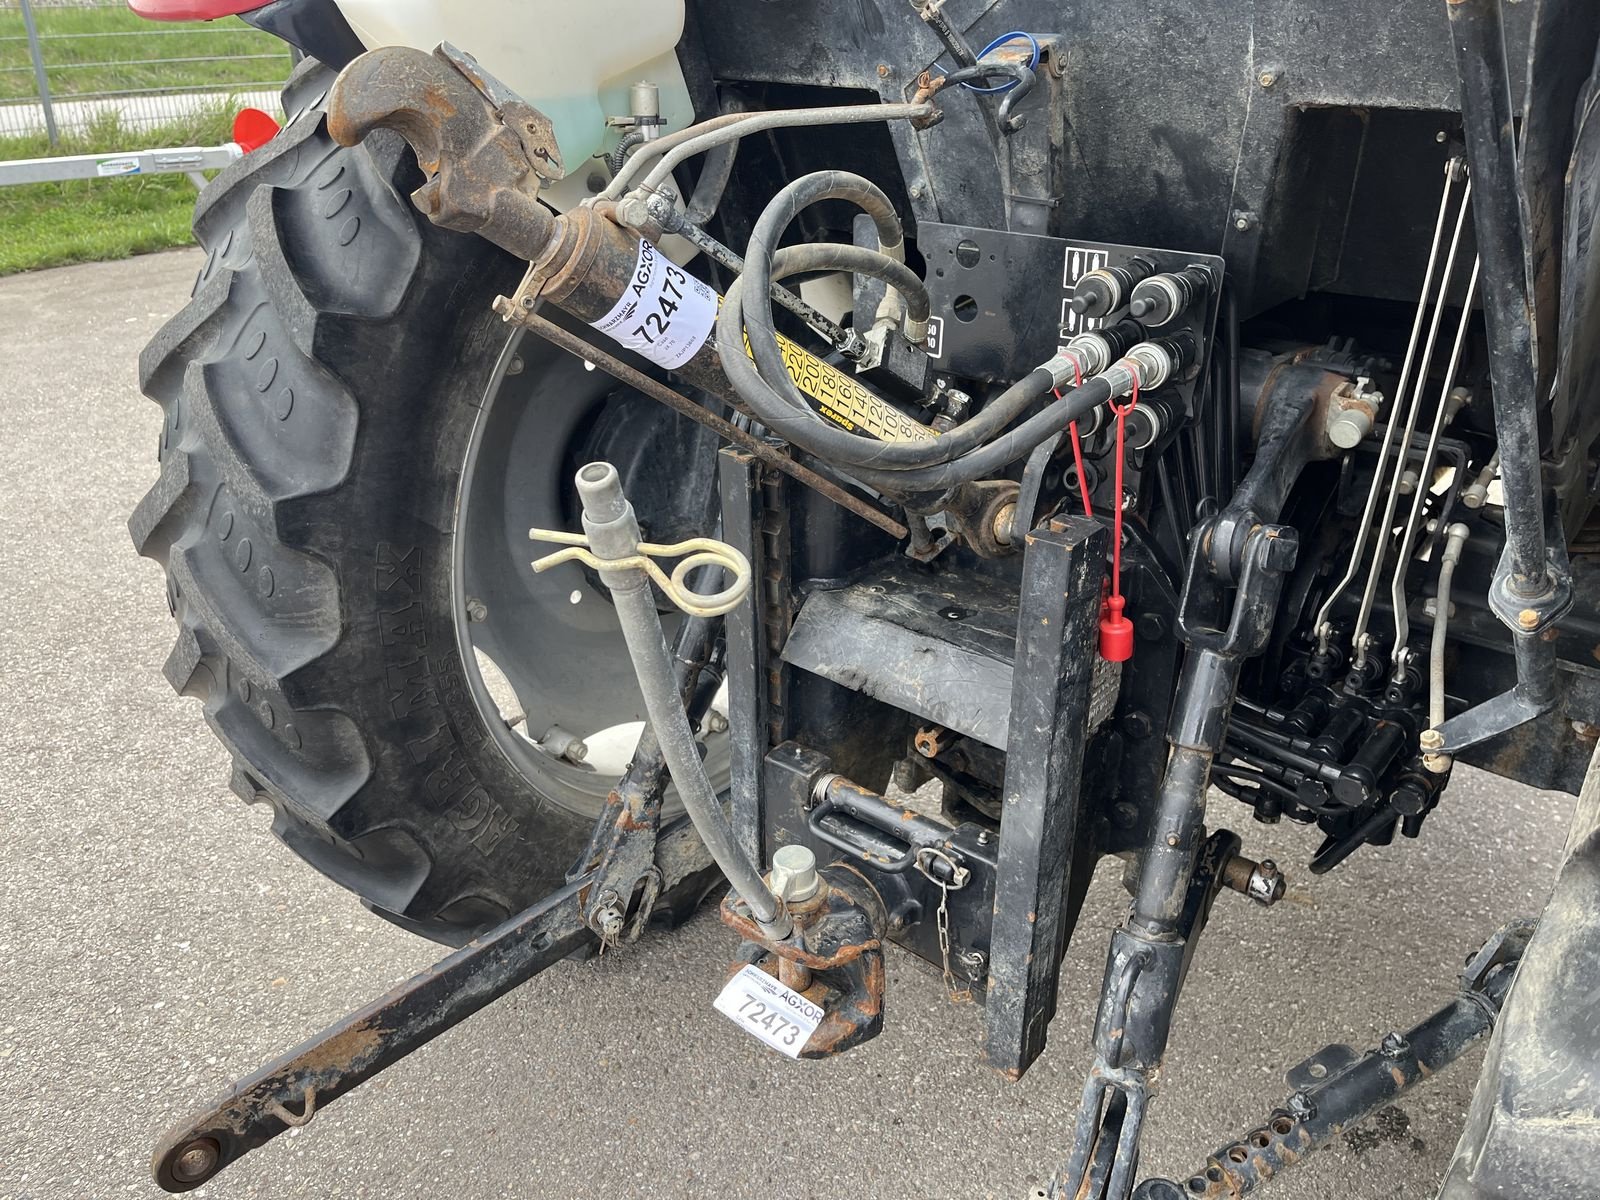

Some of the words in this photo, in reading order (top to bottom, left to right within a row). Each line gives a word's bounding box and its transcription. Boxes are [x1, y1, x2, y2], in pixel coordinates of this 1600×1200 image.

[632, 240, 653, 299] AGXOR
[632, 266, 686, 344] 72473
[787, 342, 803, 383] 220
[803, 354, 820, 394] 200
[820, 364, 836, 400] 180
[837, 376, 852, 410] 160
[852, 386, 867, 419] 140
[868, 395, 883, 430] 120
[883, 405, 898, 440] 100
[899, 415, 912, 439] 80
[375, 541, 520, 857] AGRIMAX
[738, 993, 800, 1046] 72473
[778, 990, 823, 1024] AGXOR
